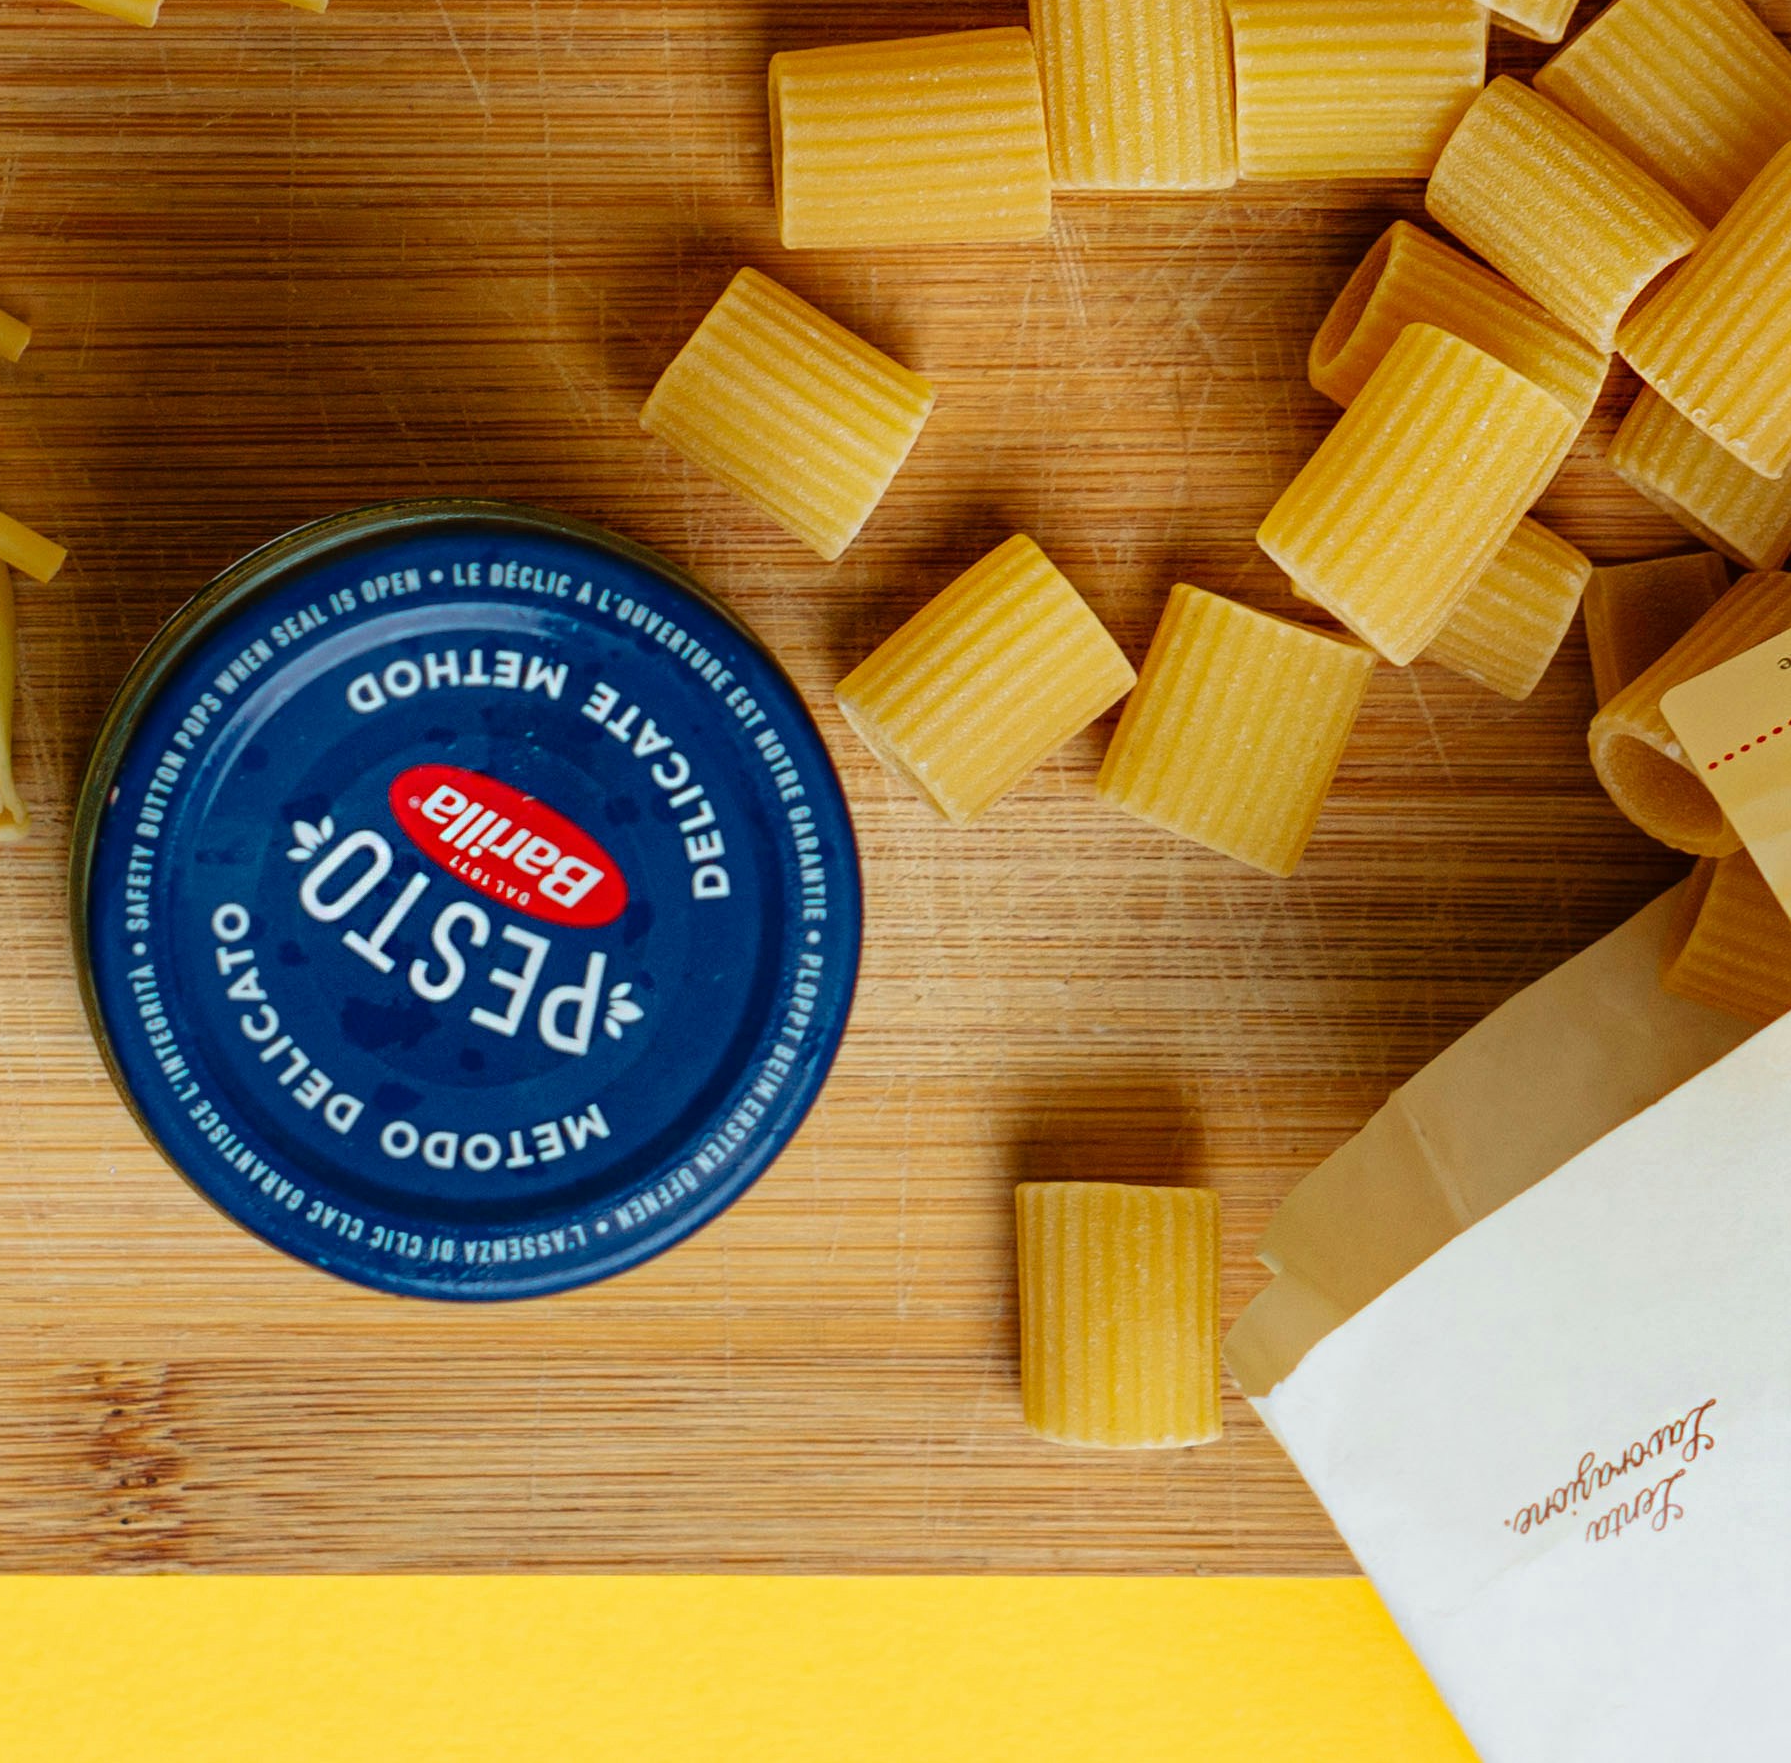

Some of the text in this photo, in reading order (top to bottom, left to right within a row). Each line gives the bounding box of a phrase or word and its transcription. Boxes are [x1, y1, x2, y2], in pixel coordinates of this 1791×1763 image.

[126, 568, 421, 932] SAFETY BUTTON POPS WHEN SEAL IS OPEN
[346, 649, 731, 900] DELICATE METHOD
[452, 560, 828, 922] LE DÉCLIC A L'OUVERTURE EST NOTRE GARANTIE
[298, 828, 608, 1057] PESTO
[495, 879, 531, 907] DAL
[211, 902, 611, 1172] METODO DELICATO
[614, 953, 824, 1230] PLOPPT BEIM ERSTEN ÖFFNEN
[188, 1099, 306, 1211] GARANTISCE
[306, 1200, 365, 1241] CLAC
[369, 1225, 423, 1259] CLIC
[430, 1237, 456, 1262] DI
[463, 1224, 587, 1265] L'ASSENZA
[1504, 1398, 1717, 1534] Lavorazione.
[1585, 1468, 1687, 1543] Lenta
